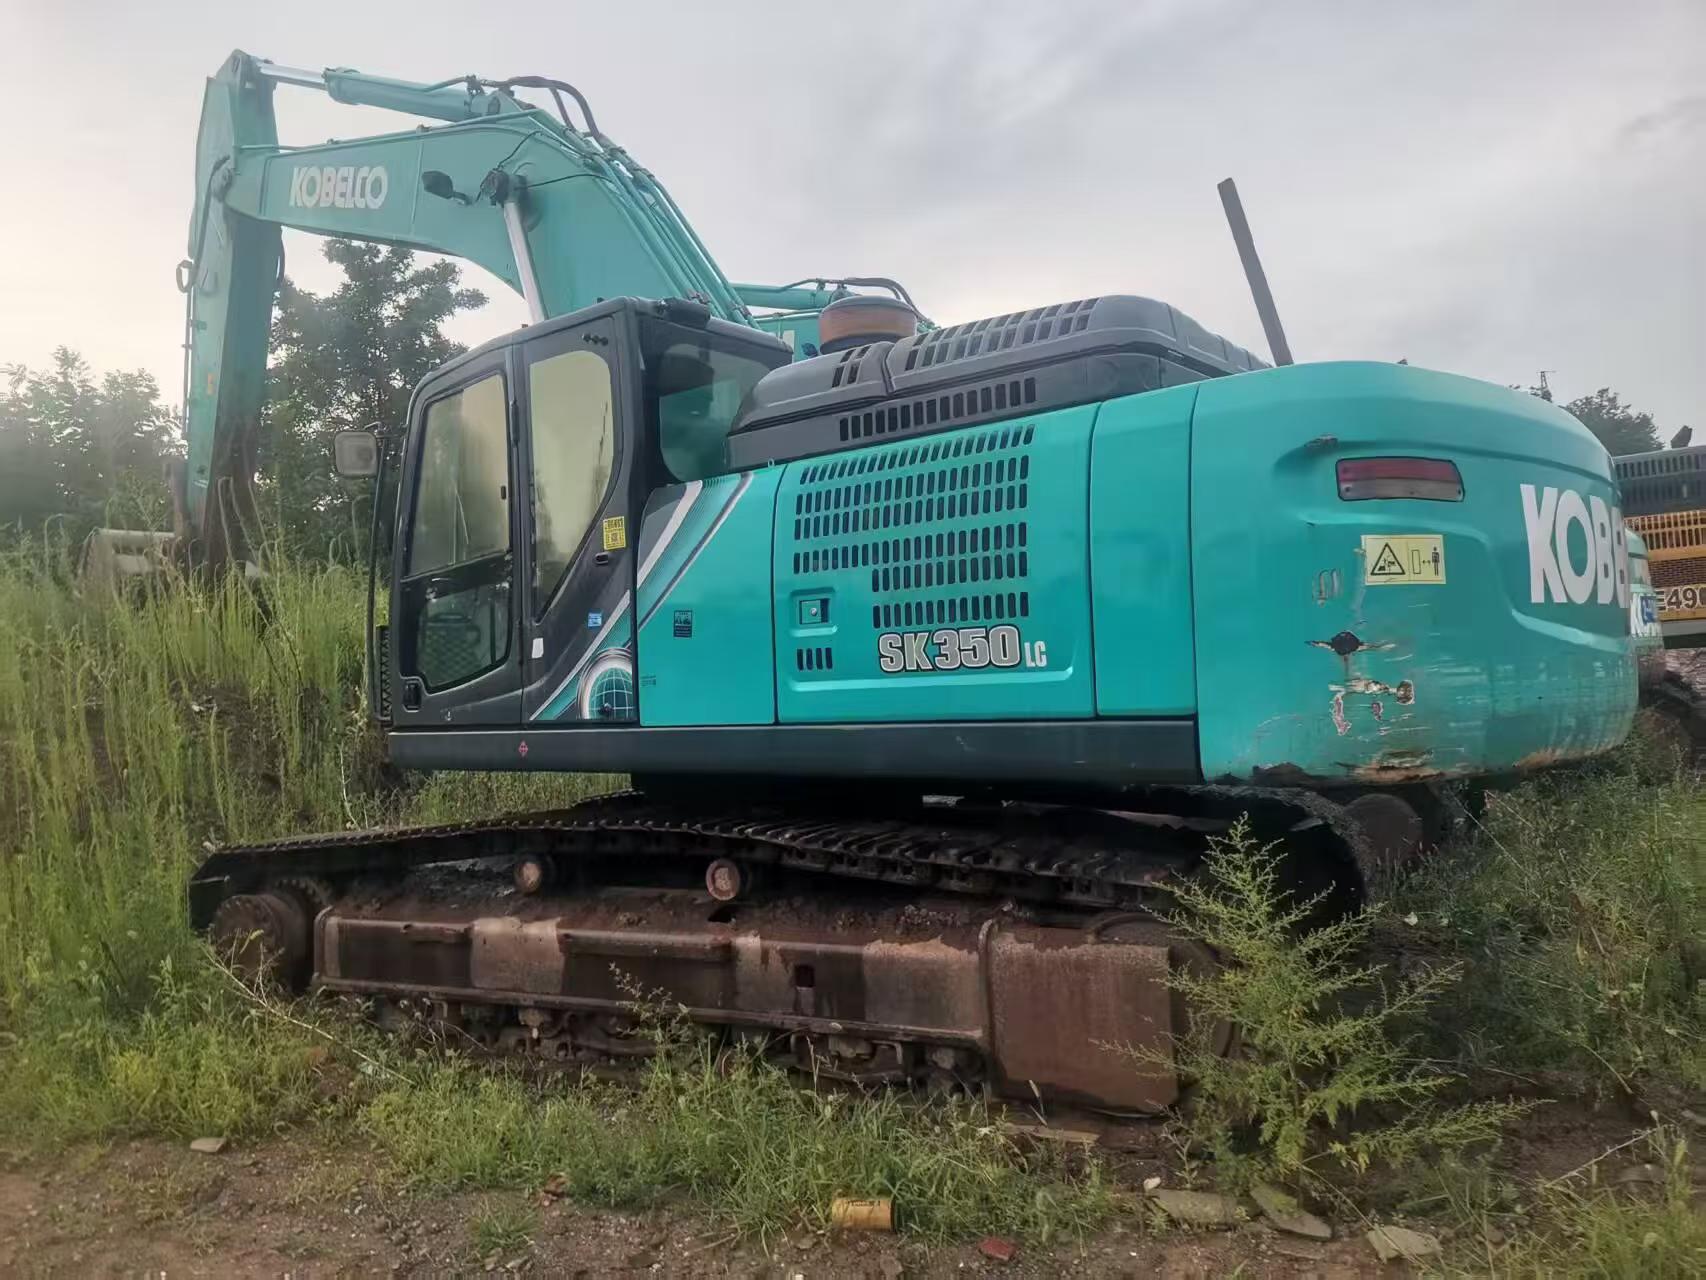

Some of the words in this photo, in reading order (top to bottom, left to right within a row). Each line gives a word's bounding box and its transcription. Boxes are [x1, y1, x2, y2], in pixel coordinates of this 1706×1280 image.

[290, 166, 388, 209] KOBELCO
[878, 625, 1021, 672] SK350
[1024, 641, 1047, 667] LC
